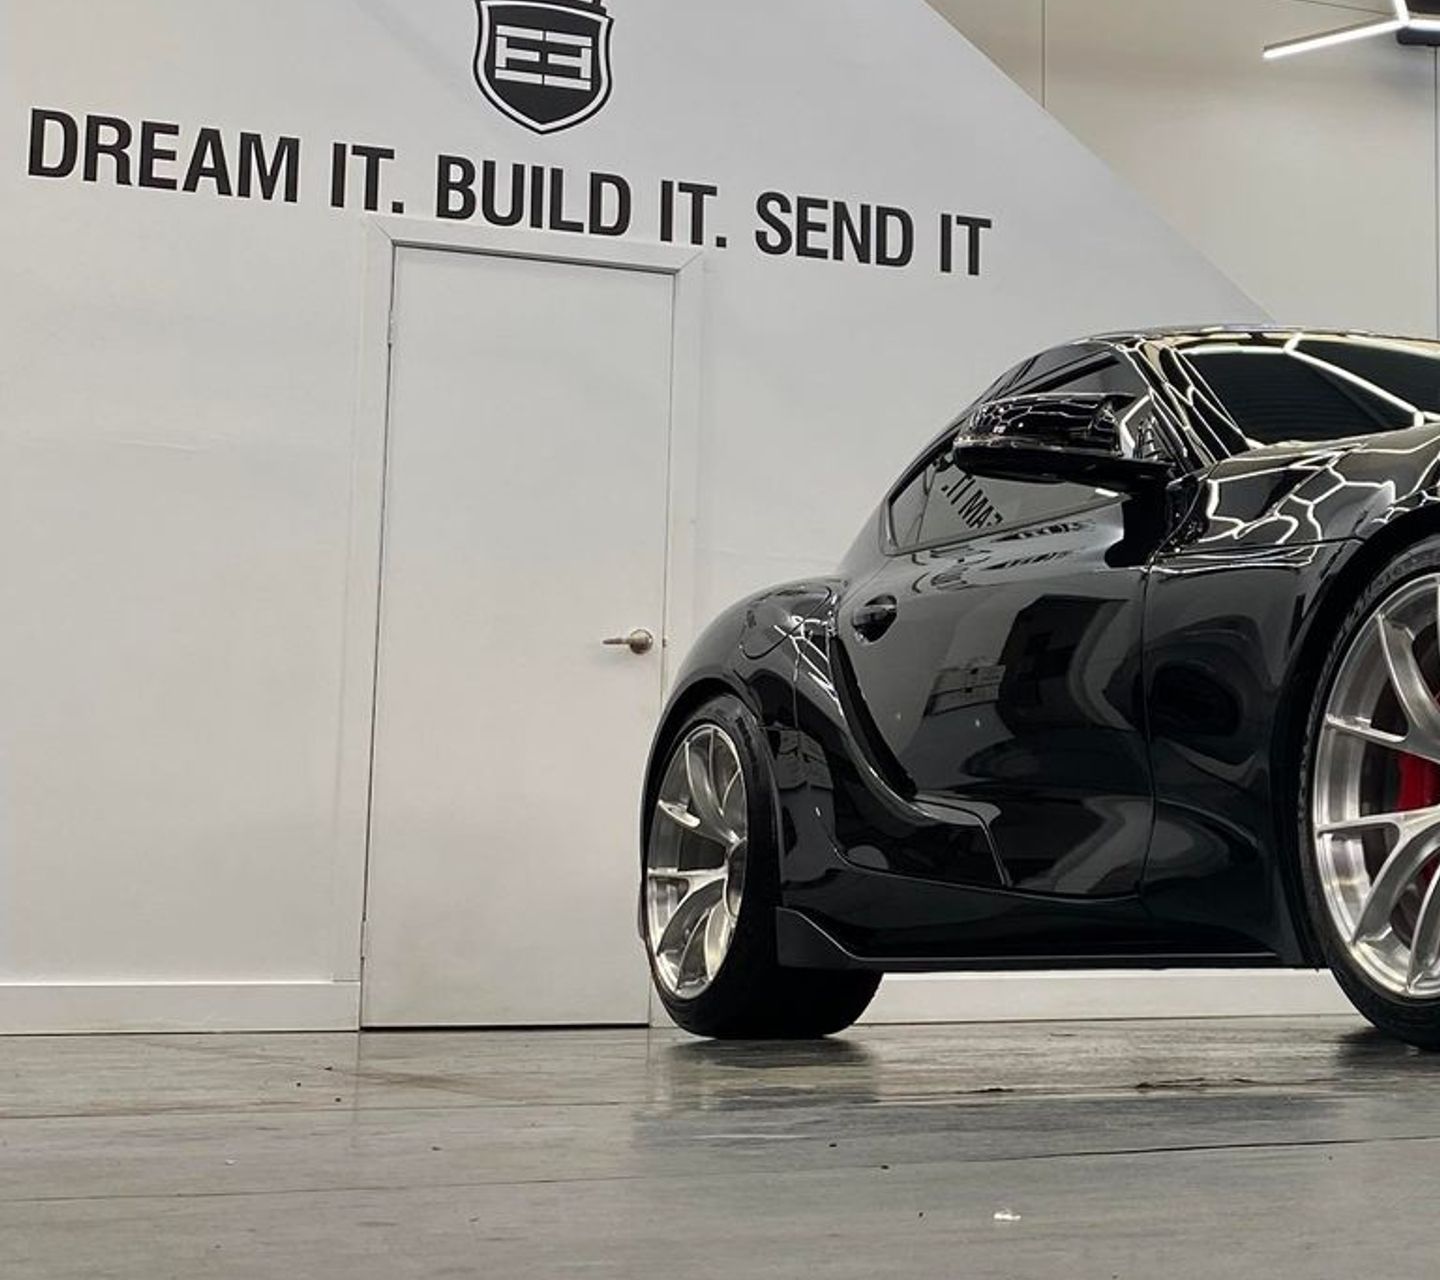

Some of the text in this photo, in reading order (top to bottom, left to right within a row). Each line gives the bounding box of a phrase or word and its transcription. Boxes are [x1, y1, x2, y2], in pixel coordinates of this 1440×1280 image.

[28, 108, 992, 276] DREAM IT. BUILD IT. SEND IT
